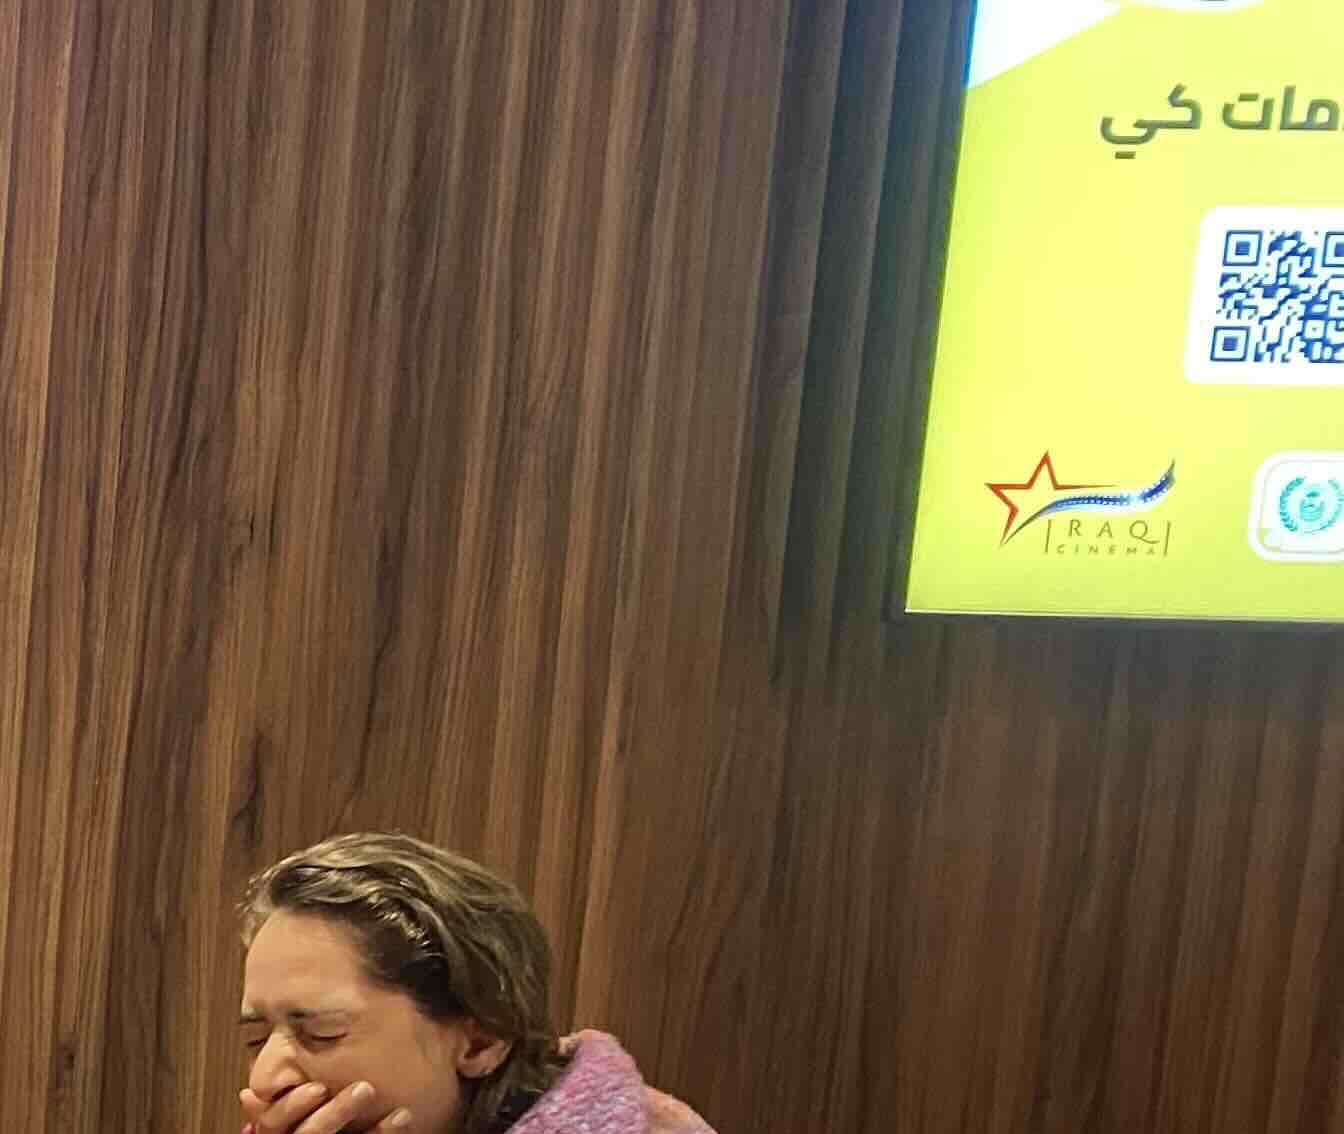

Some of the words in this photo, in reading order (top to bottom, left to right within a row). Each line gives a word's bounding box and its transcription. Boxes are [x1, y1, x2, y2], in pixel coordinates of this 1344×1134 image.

[1100, 83, 1201, 159] كي
[1221, 84, 1344, 131] مات
[1056, 543, 1156, 556] CINEMA
